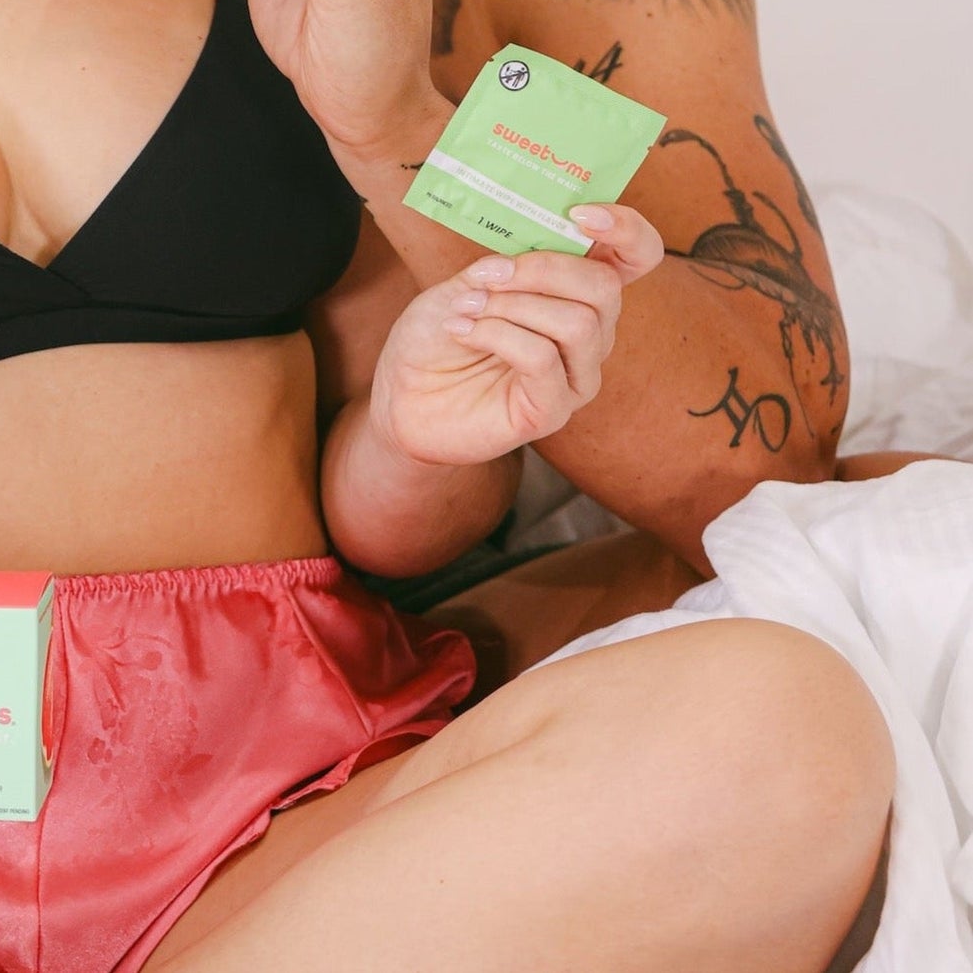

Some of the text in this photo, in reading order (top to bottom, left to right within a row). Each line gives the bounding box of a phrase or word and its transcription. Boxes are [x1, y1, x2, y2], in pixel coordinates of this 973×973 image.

[455, 167, 496, 194] INTIMATE
[494, 189, 517, 205] WIPE
[515, 200, 537, 217] WITH
[477, 216, 513, 239] 1 WIPE
